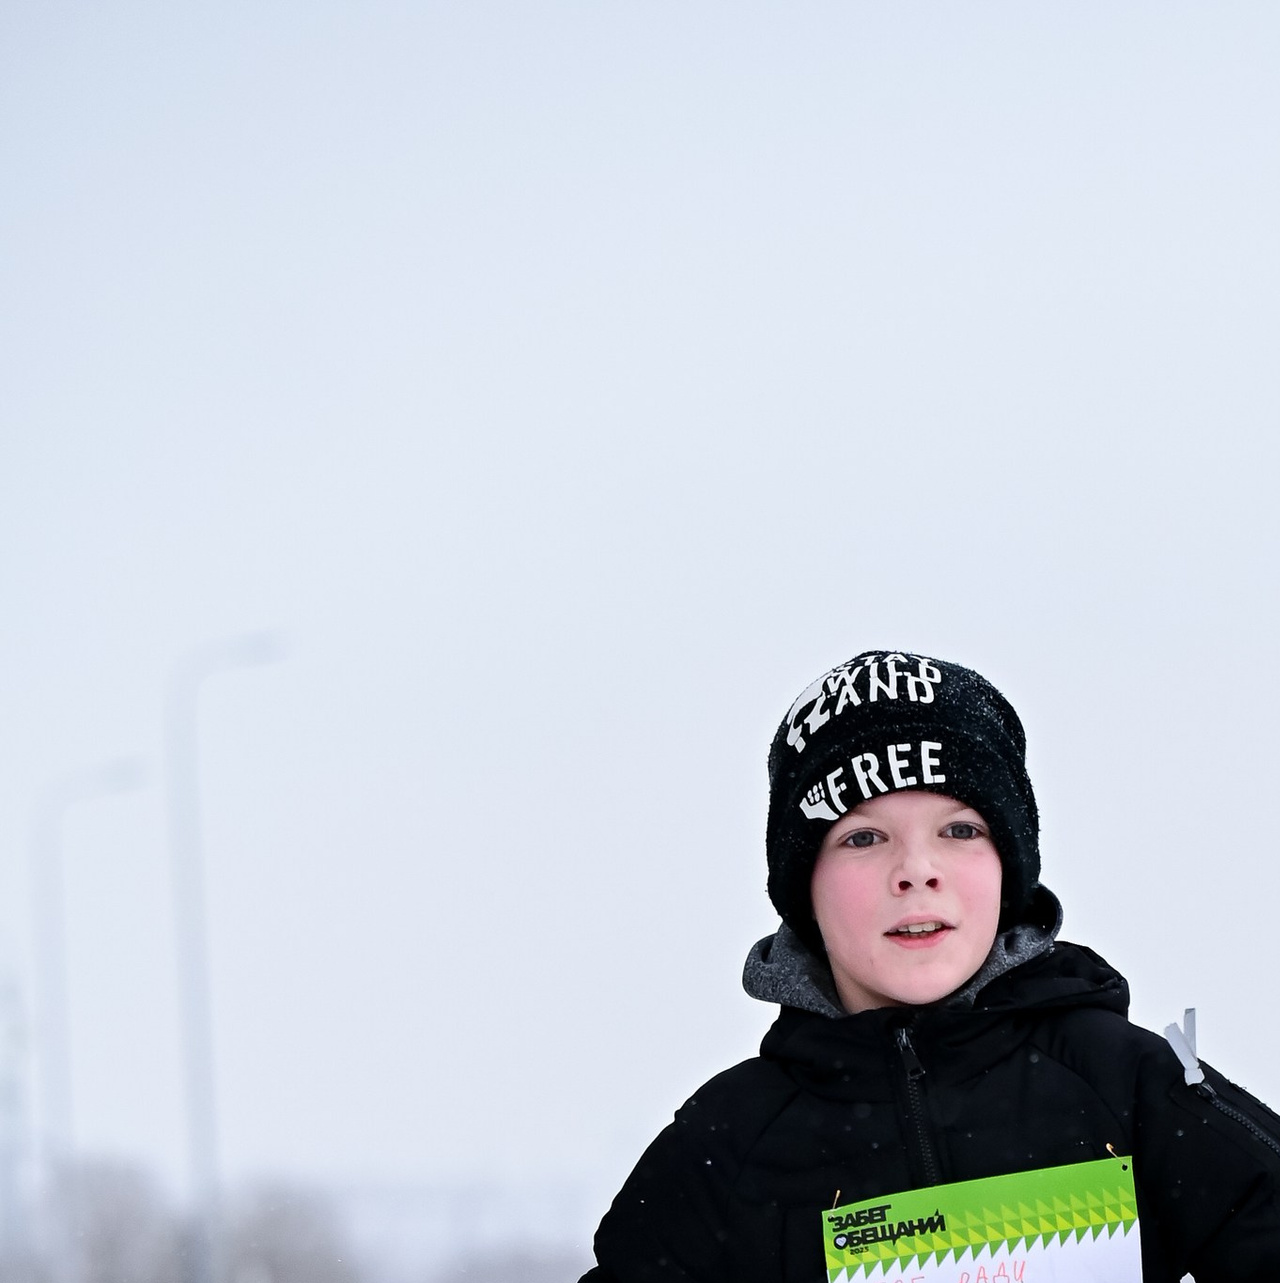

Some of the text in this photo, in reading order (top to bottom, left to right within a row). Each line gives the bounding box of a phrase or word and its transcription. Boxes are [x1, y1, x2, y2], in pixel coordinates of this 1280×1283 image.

[826, 741, 946, 813] FREE
[832, 1204, 892, 1232] ЗАБЕГ
[833, 1208, 947, 1250] ОБЕЩАНИЙ
